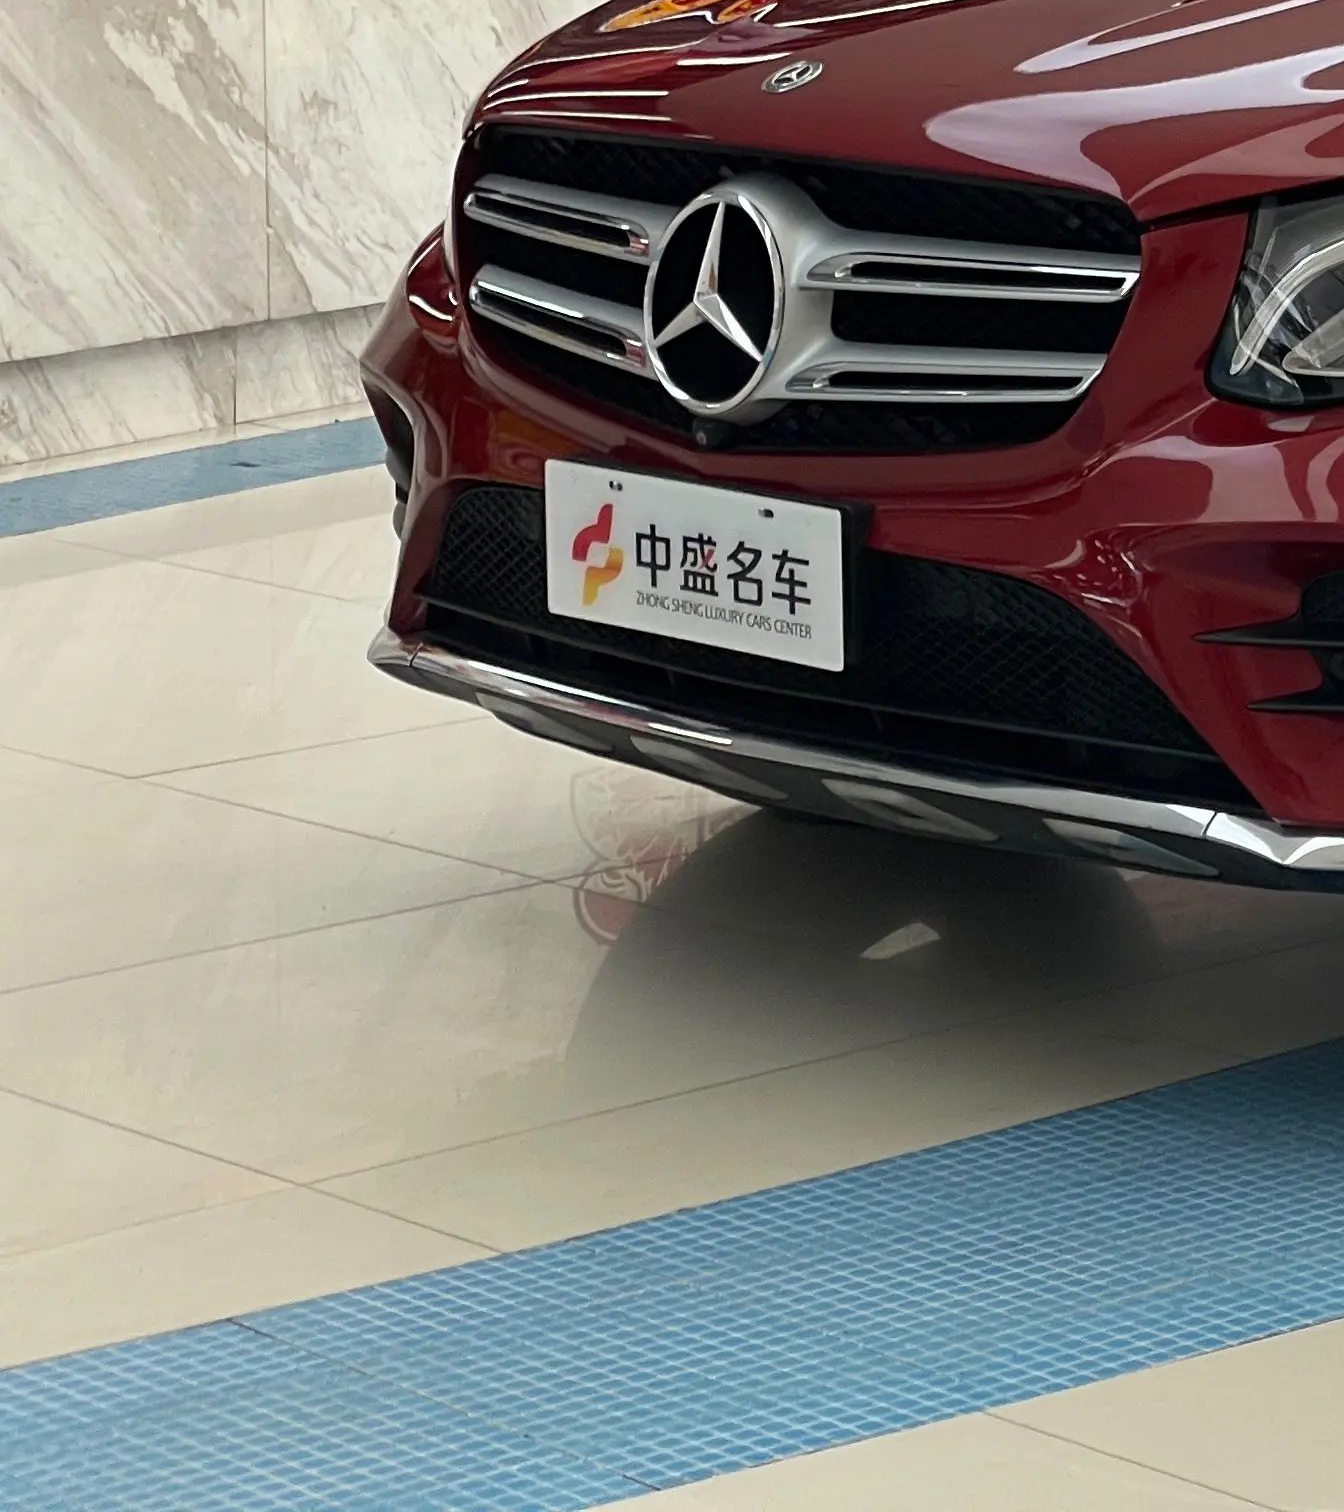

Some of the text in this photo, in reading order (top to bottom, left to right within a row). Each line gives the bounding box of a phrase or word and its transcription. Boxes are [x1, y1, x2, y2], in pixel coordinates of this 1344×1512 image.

[635, 524, 811, 615] 中盛名车
[636, 590, 812, 639] ZHONG SHENG LUXURY CARS CENTER
